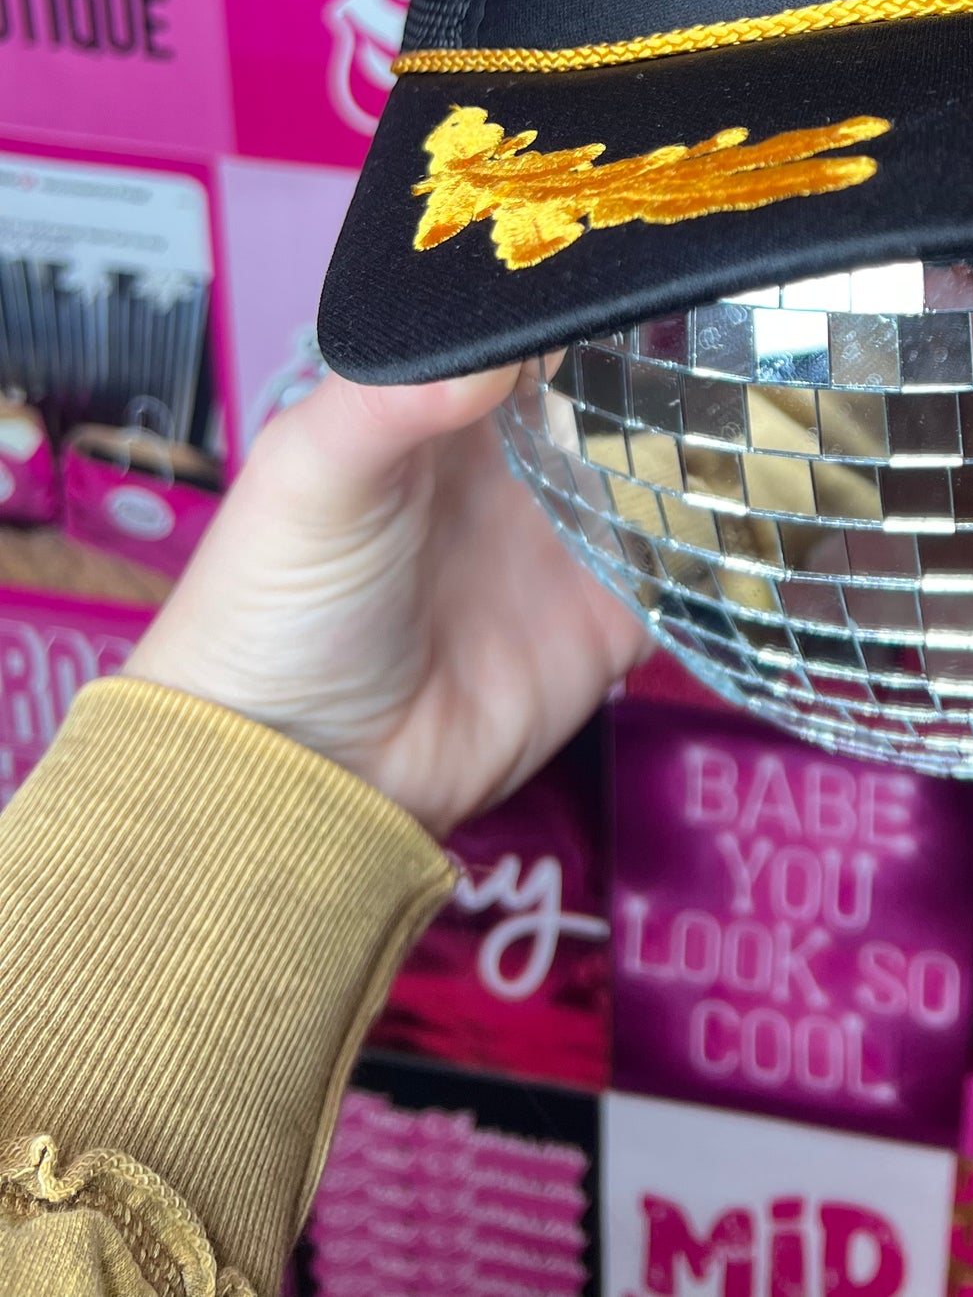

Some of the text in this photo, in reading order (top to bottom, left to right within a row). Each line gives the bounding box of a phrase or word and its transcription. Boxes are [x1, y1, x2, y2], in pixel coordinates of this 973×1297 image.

[682, 746, 917, 858] BABE
[717, 832, 876, 930] YOU
[624, 894, 962, 1030] LOOK SO
[689, 1000, 898, 1104] COOL
